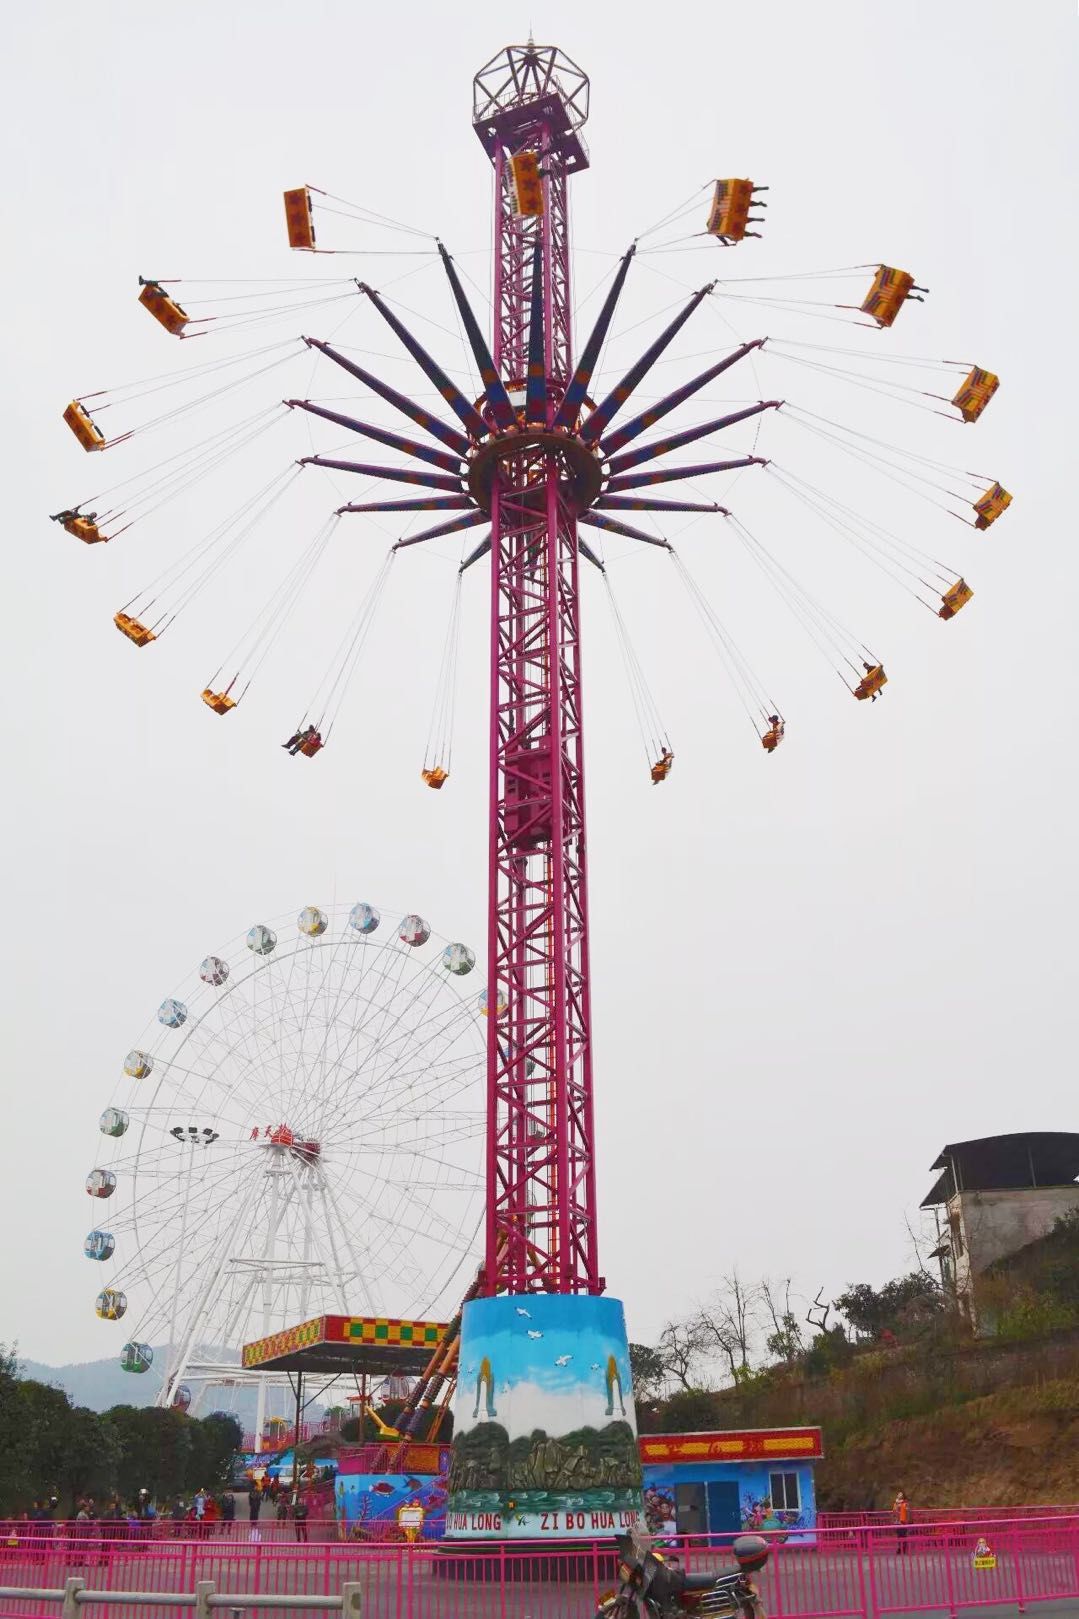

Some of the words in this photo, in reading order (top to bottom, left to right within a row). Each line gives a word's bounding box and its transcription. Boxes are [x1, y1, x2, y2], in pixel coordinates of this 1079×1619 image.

[453, 1512, 468, 1531] HUA
[471, 1513, 502, 1531] LONG
[540, 1512, 559, 1530] ZI
[565, 1512, 585, 1530] BO
[591, 1512, 615, 1529] HUA
